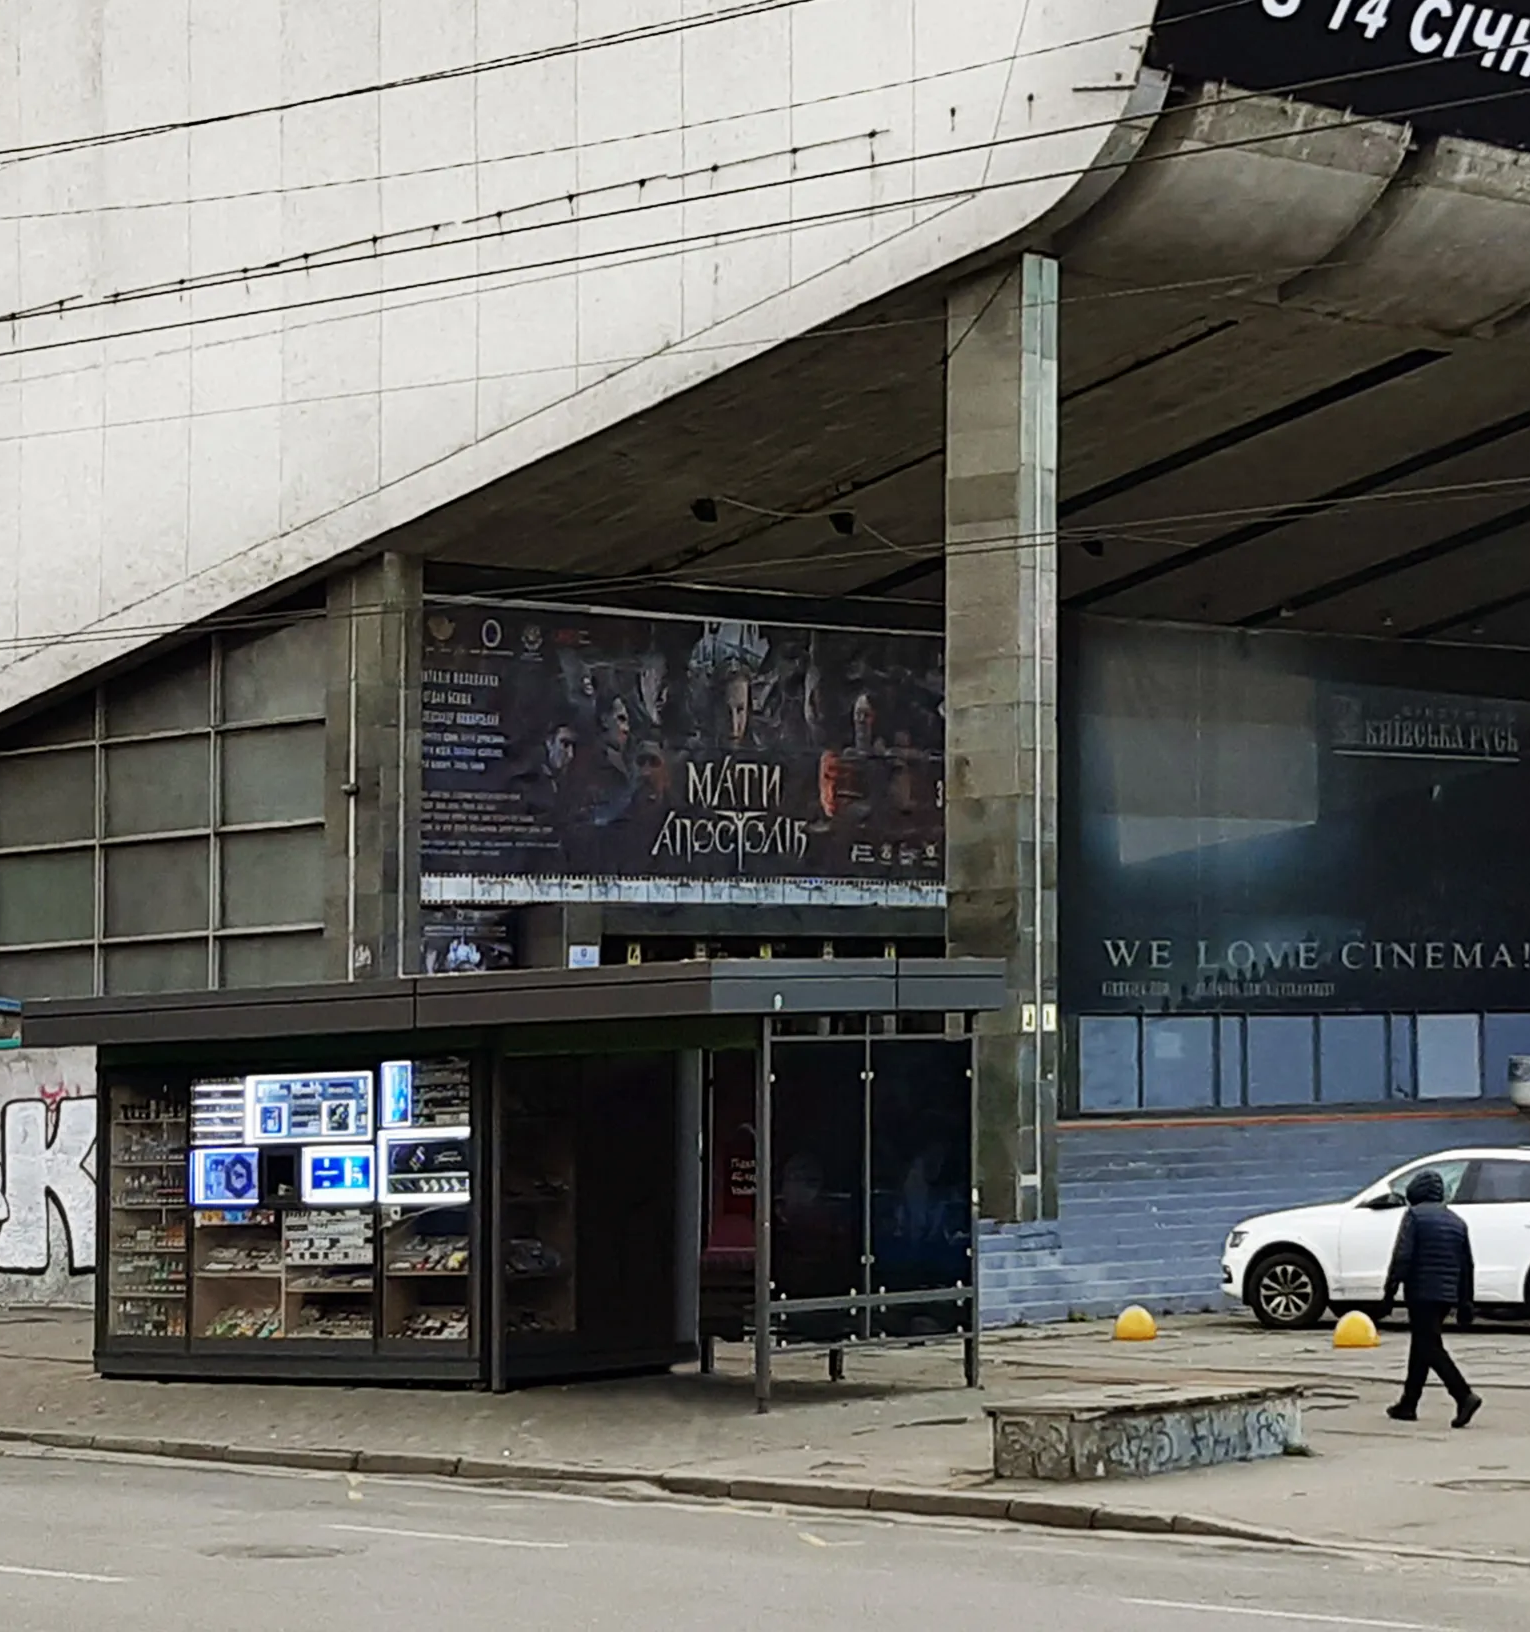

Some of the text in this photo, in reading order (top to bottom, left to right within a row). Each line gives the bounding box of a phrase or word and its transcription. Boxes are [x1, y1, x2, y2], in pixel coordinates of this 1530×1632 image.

[687, 756, 781, 806] МАТИ
[1104, 940, 1172, 967] WE
[1198, 940, 1318, 969] LOVE
